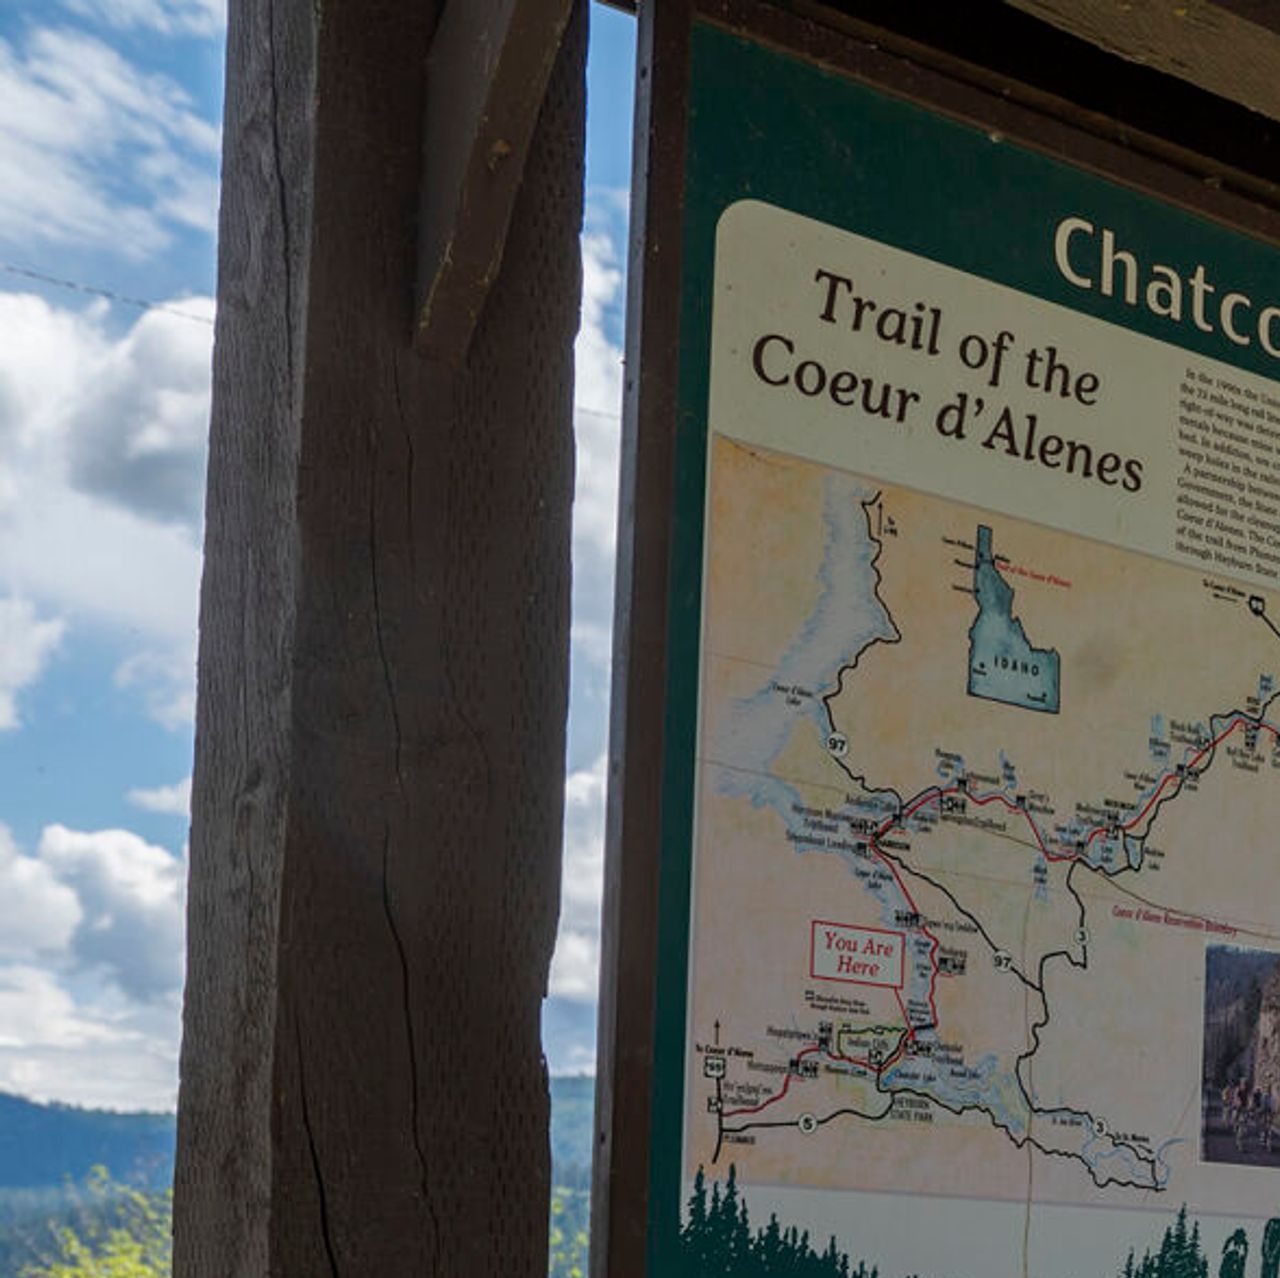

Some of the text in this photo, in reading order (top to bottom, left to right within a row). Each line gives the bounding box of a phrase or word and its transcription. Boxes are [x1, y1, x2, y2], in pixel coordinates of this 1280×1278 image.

[815, 267, 1100, 406] Trail of the
[751, 333, 1145, 493] Coeur d'Alenes
[994, 655, 1039, 676] IDAHO
[828, 738, 846, 751] 97
[824, 931, 893, 957] You Are
[837, 955, 880, 977] Here
[994, 956, 1011, 968] 97
